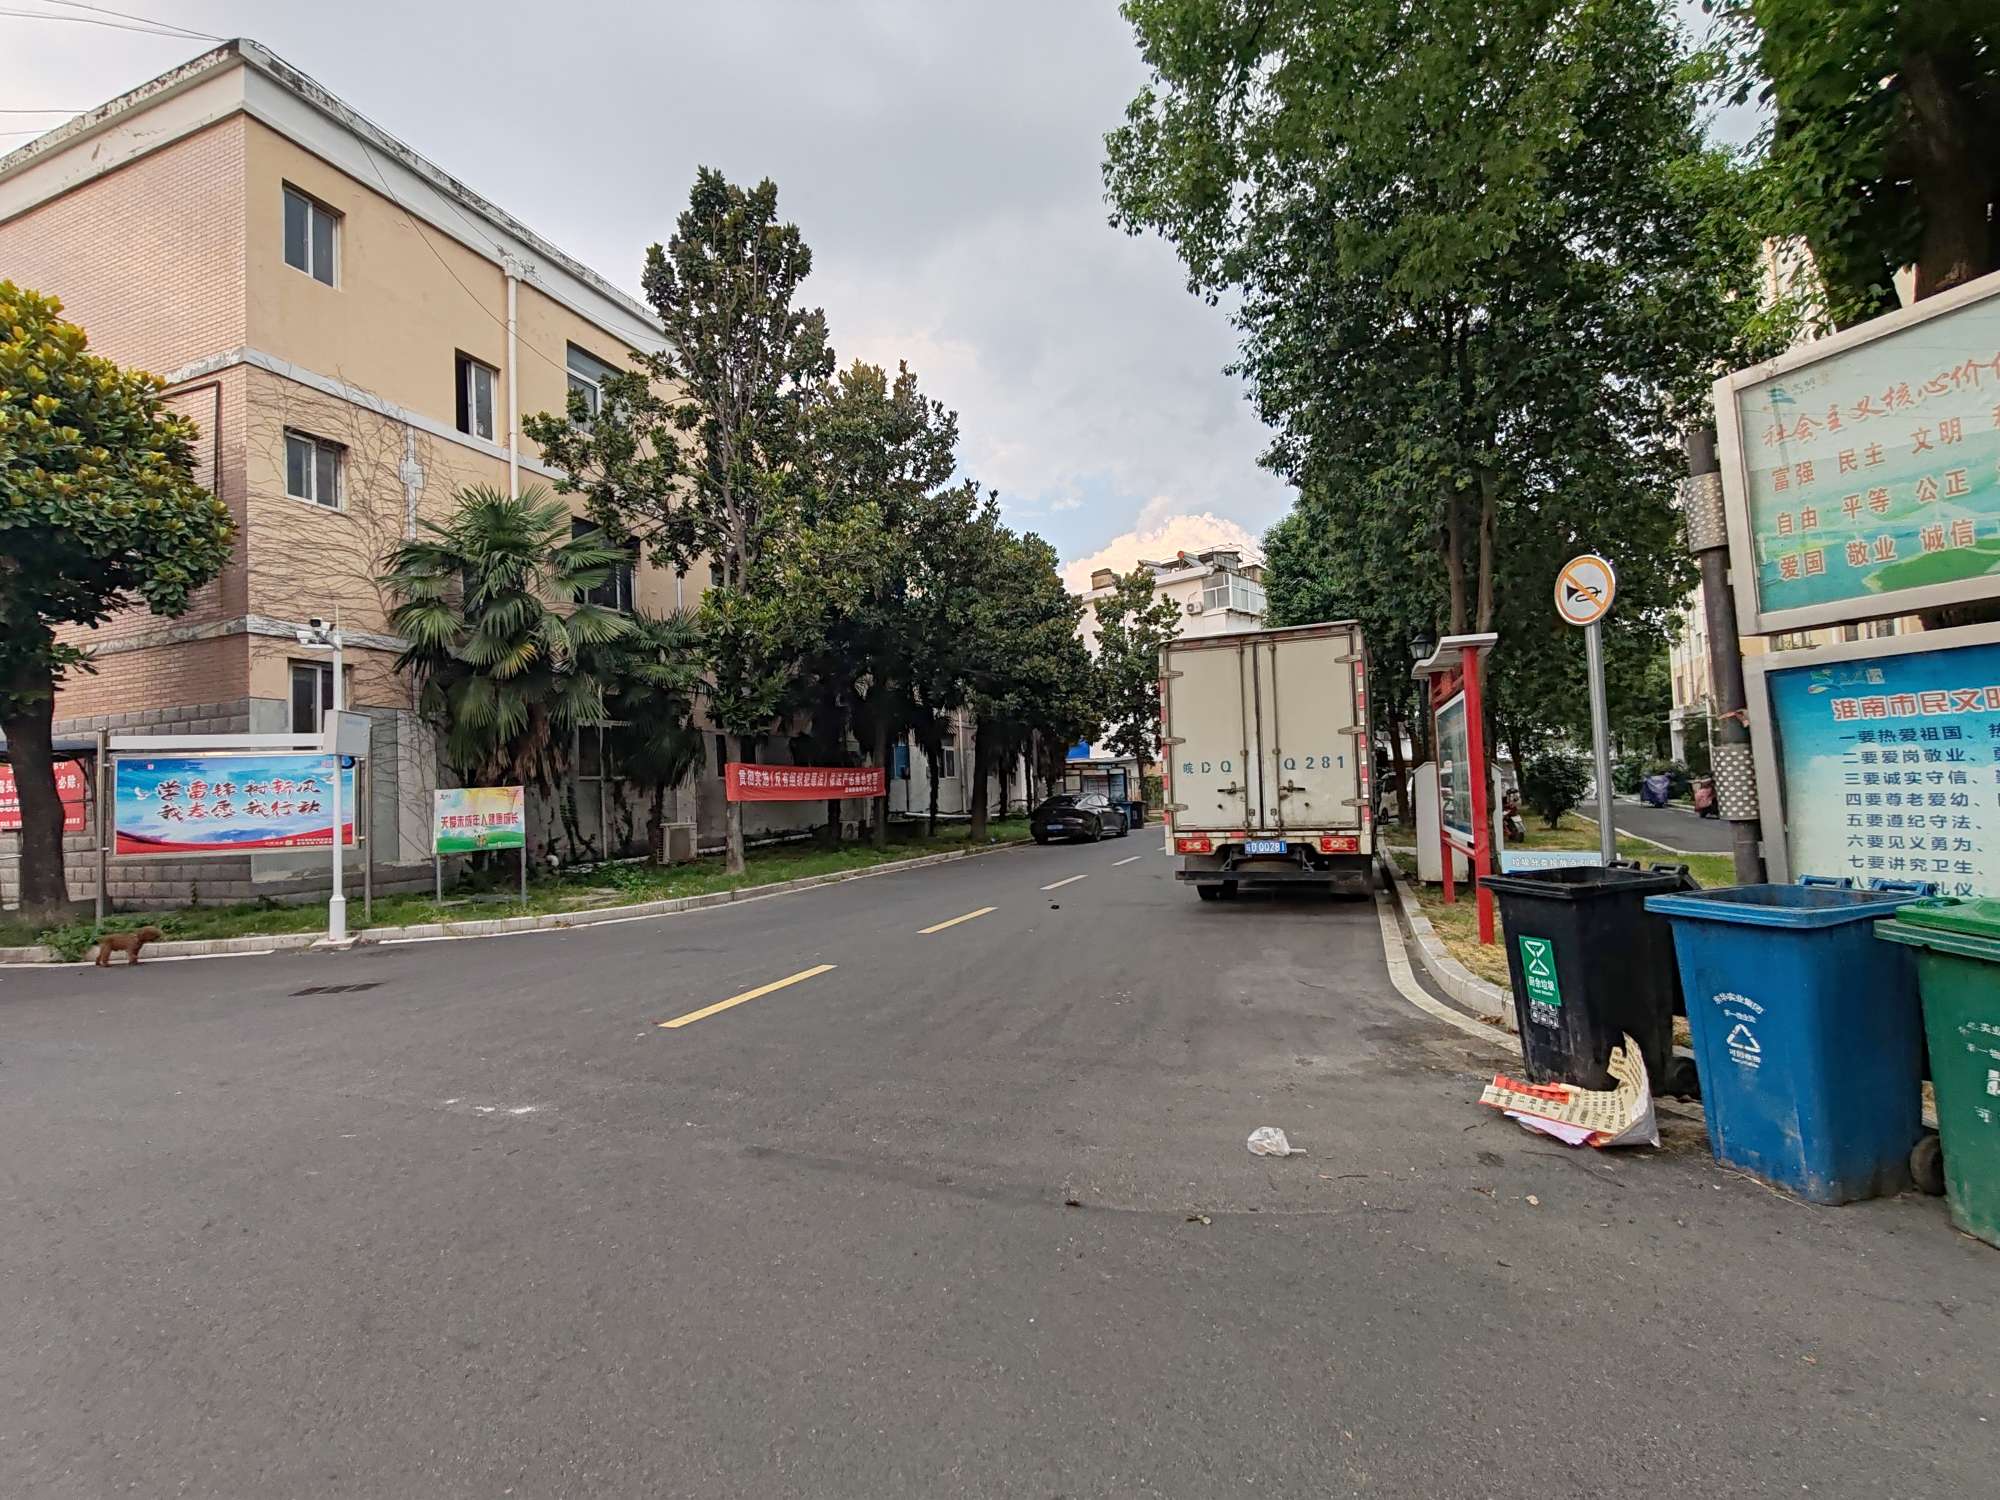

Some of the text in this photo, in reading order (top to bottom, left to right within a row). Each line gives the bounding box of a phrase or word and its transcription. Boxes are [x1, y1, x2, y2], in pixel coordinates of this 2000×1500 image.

[1772, 461, 1815, 493] 富强
[1839, 442, 1885, 474] 民主
[1910, 416, 1962, 454] 文明
[1777, 469, 1970, 536] 自由 平等 公正
[1780, 519, 1975, 580] 爱国 敬业 诚信
[157, 779, 321, 801] 学雷锋 树新风
[157, 800, 321, 822] 我志愿 我行动
[1847, 834, 1984, 853] 六要见义勇为、
[1848, 855, 1984, 876] 七要讲究卫生、
